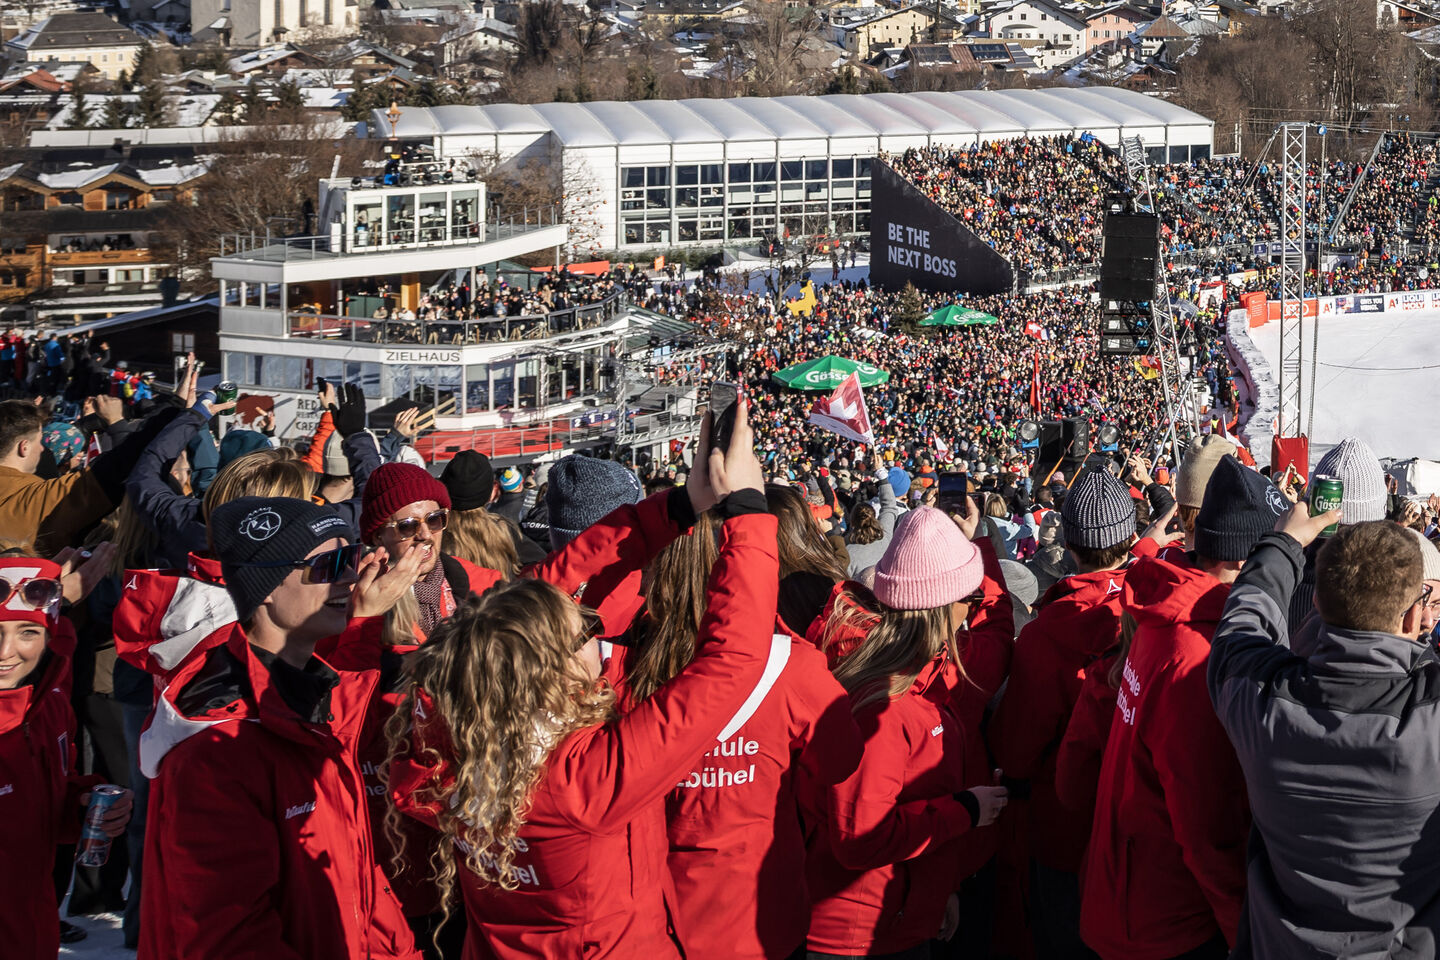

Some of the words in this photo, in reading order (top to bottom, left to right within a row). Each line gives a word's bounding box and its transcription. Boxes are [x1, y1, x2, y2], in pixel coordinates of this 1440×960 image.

[888, 222, 903, 242] BE
[906, 227, 930, 249] THE
[888, 245, 920, 269] NEXT
[924, 253, 957, 278] BOSS
[386, 351, 460, 362] ZIELHAUS
[805, 370, 850, 383] Gösse
